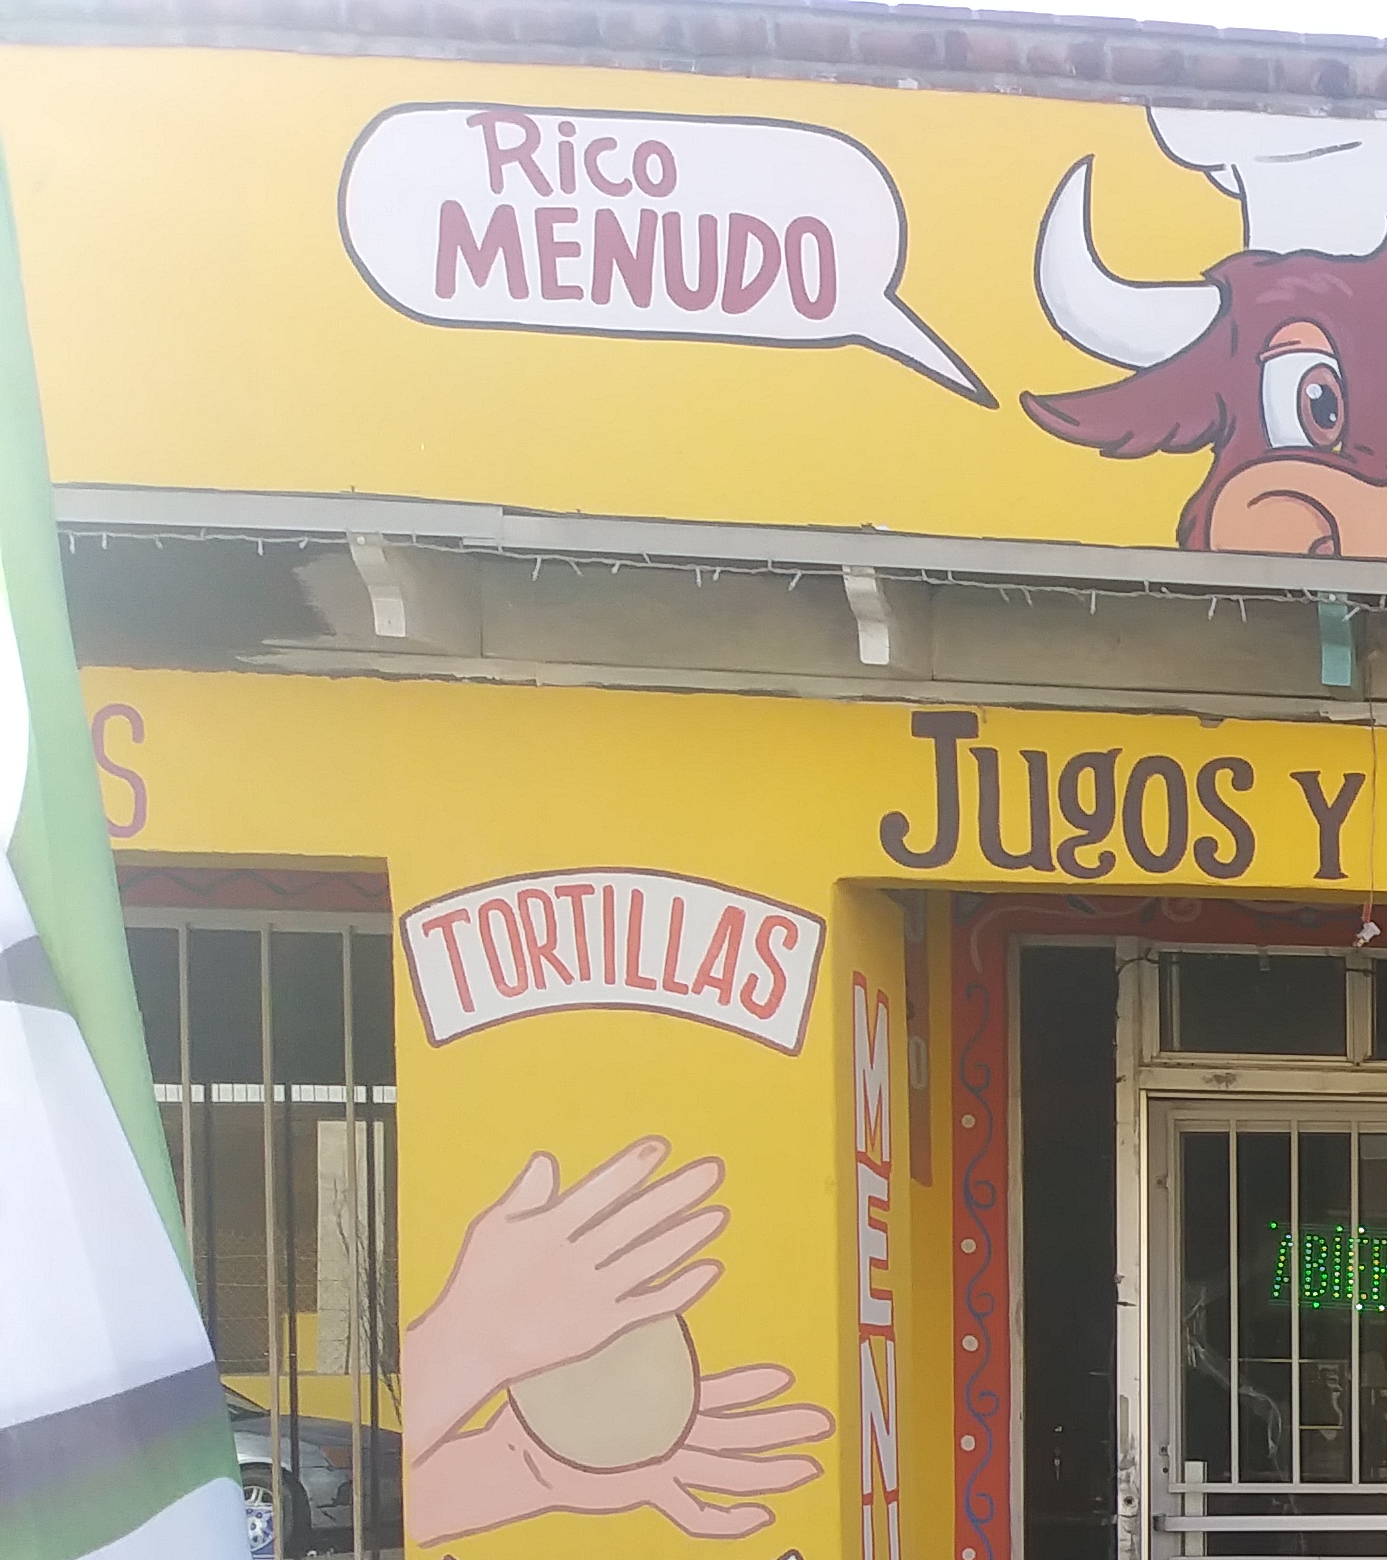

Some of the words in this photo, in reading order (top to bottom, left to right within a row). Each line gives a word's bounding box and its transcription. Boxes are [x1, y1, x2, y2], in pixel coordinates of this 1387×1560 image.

[466, 110, 678, 199] Rico
[434, 199, 838, 321] MENUDO
[880, 709, 1257, 880] Jugos
[421, 884, 800, 1020] TORTILLAS
